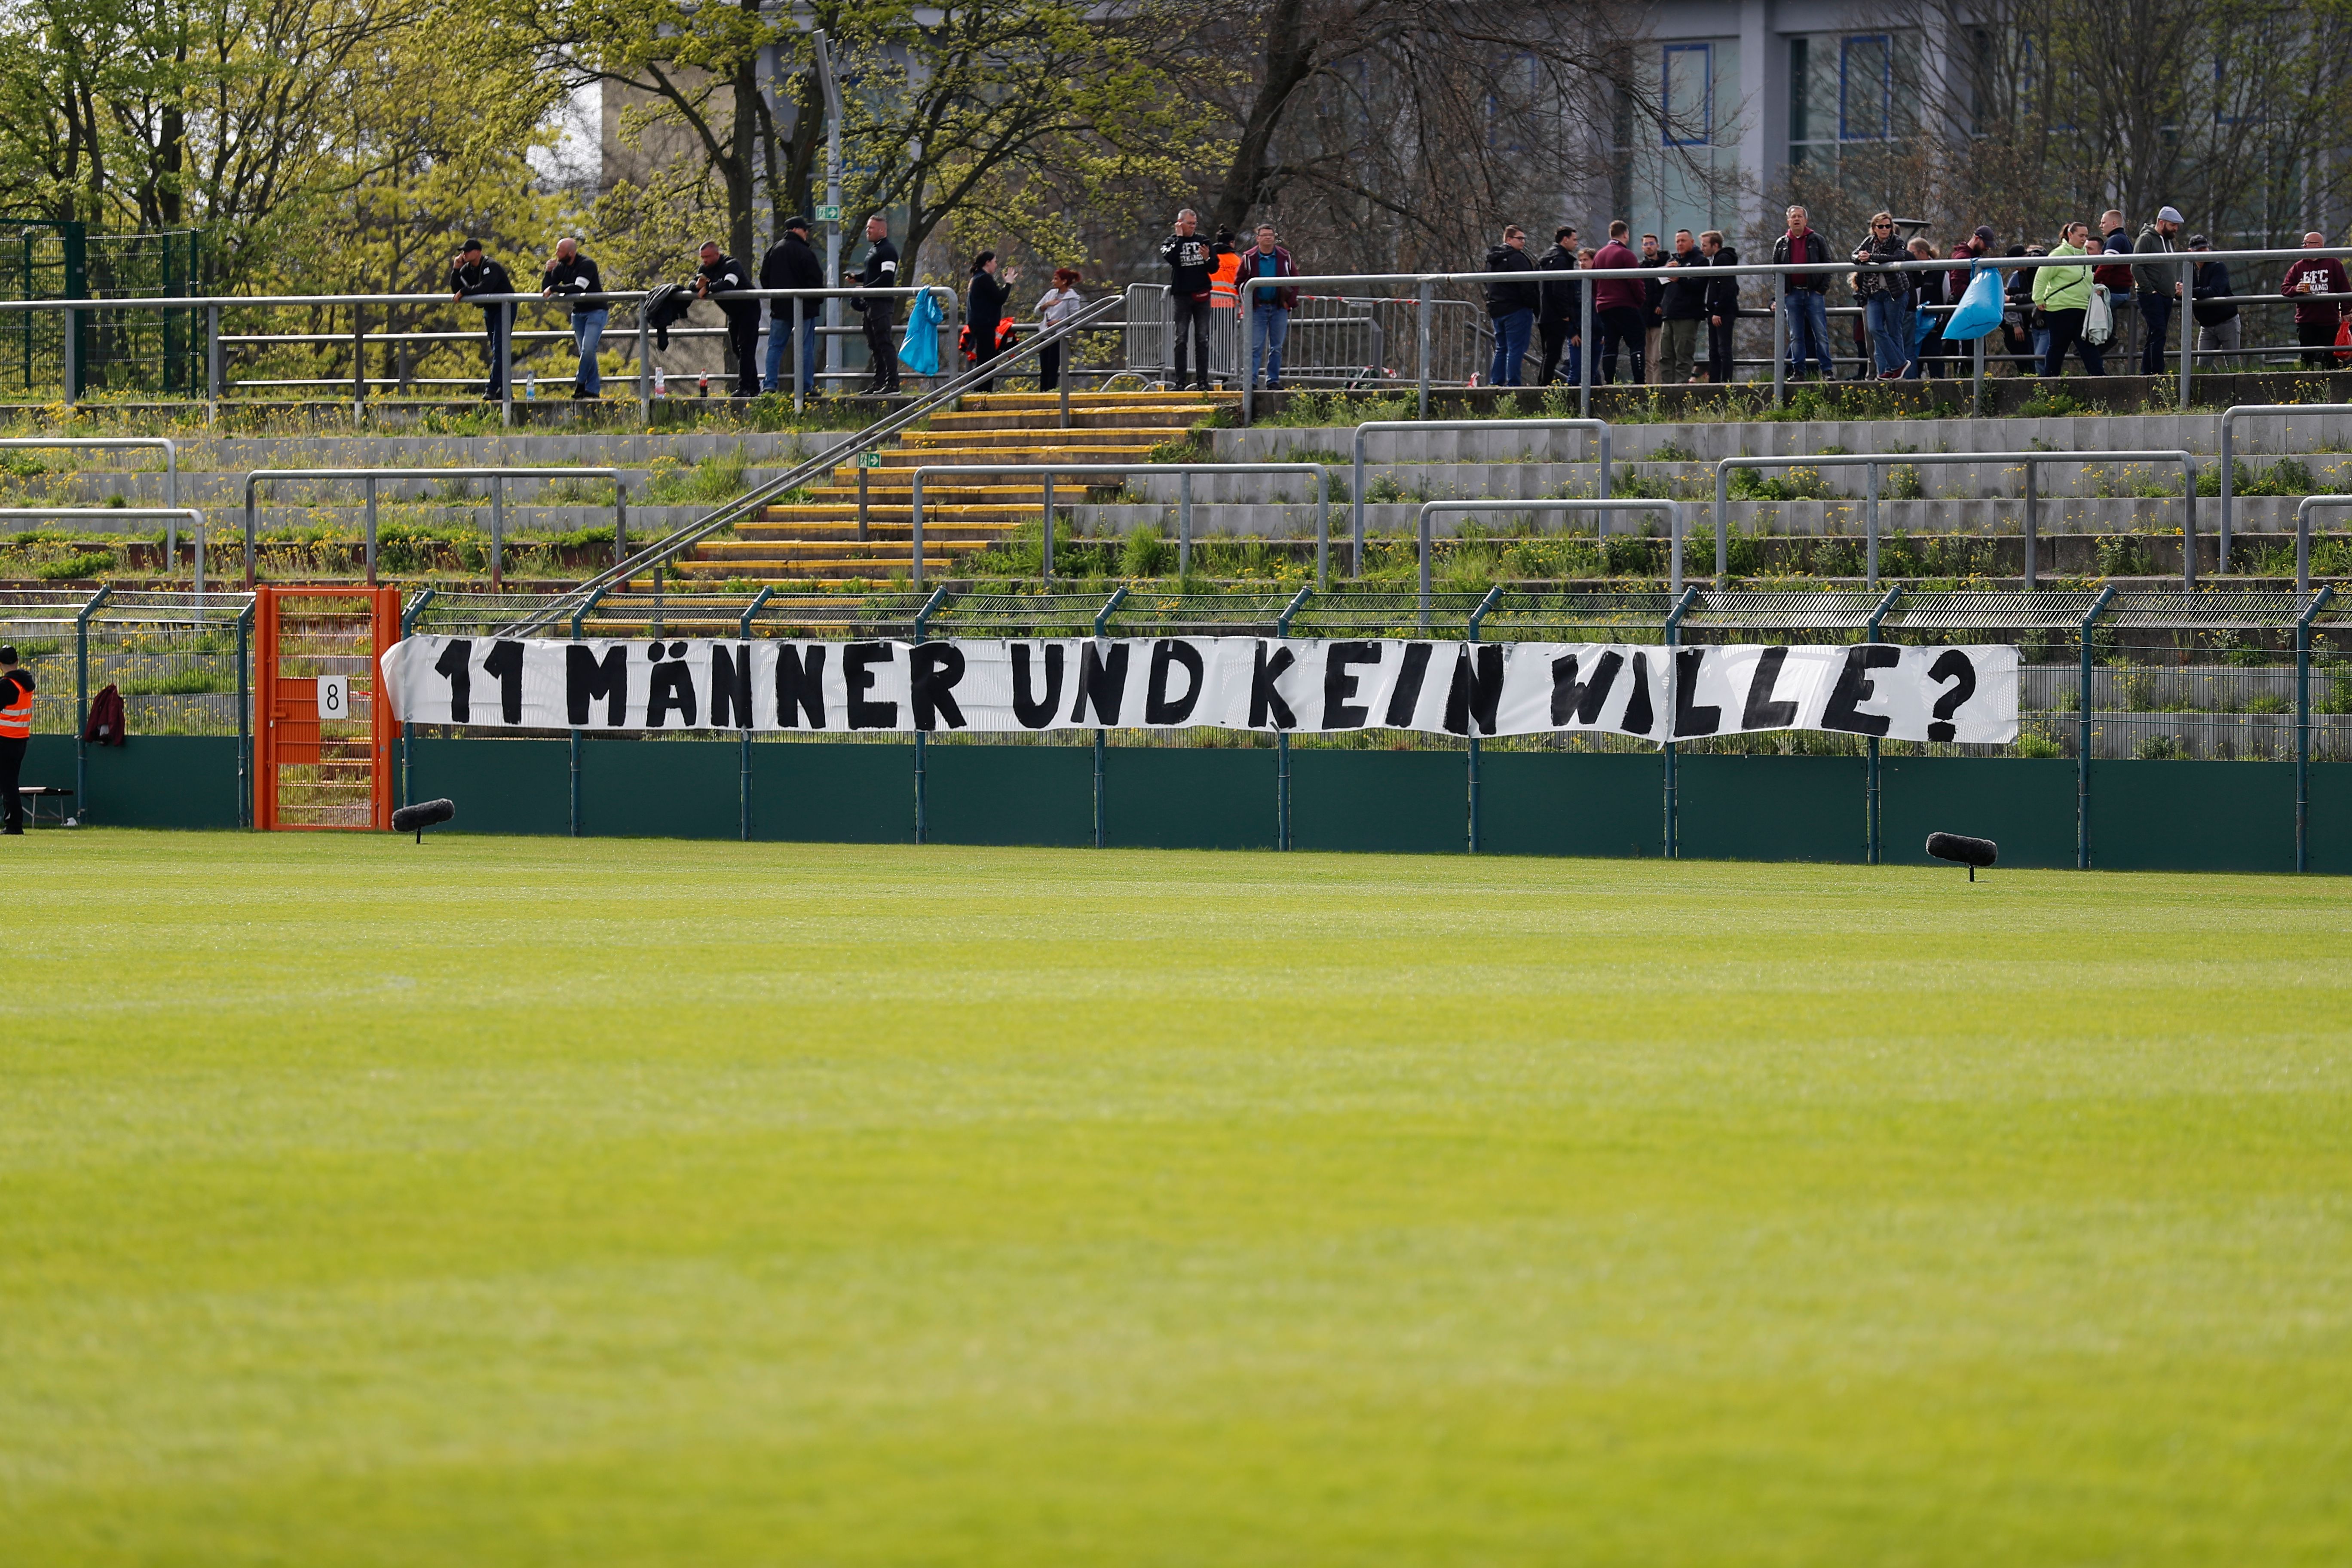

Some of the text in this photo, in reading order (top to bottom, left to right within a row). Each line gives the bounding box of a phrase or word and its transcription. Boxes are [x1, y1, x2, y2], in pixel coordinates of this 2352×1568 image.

[327, 684, 339, 710] 8
[435, 640, 524, 725] 11
[567, 640, 967, 731] MÄNNER
[1011, 639, 1203, 729] UND
[1248, 640, 1505, 735] KEIN
